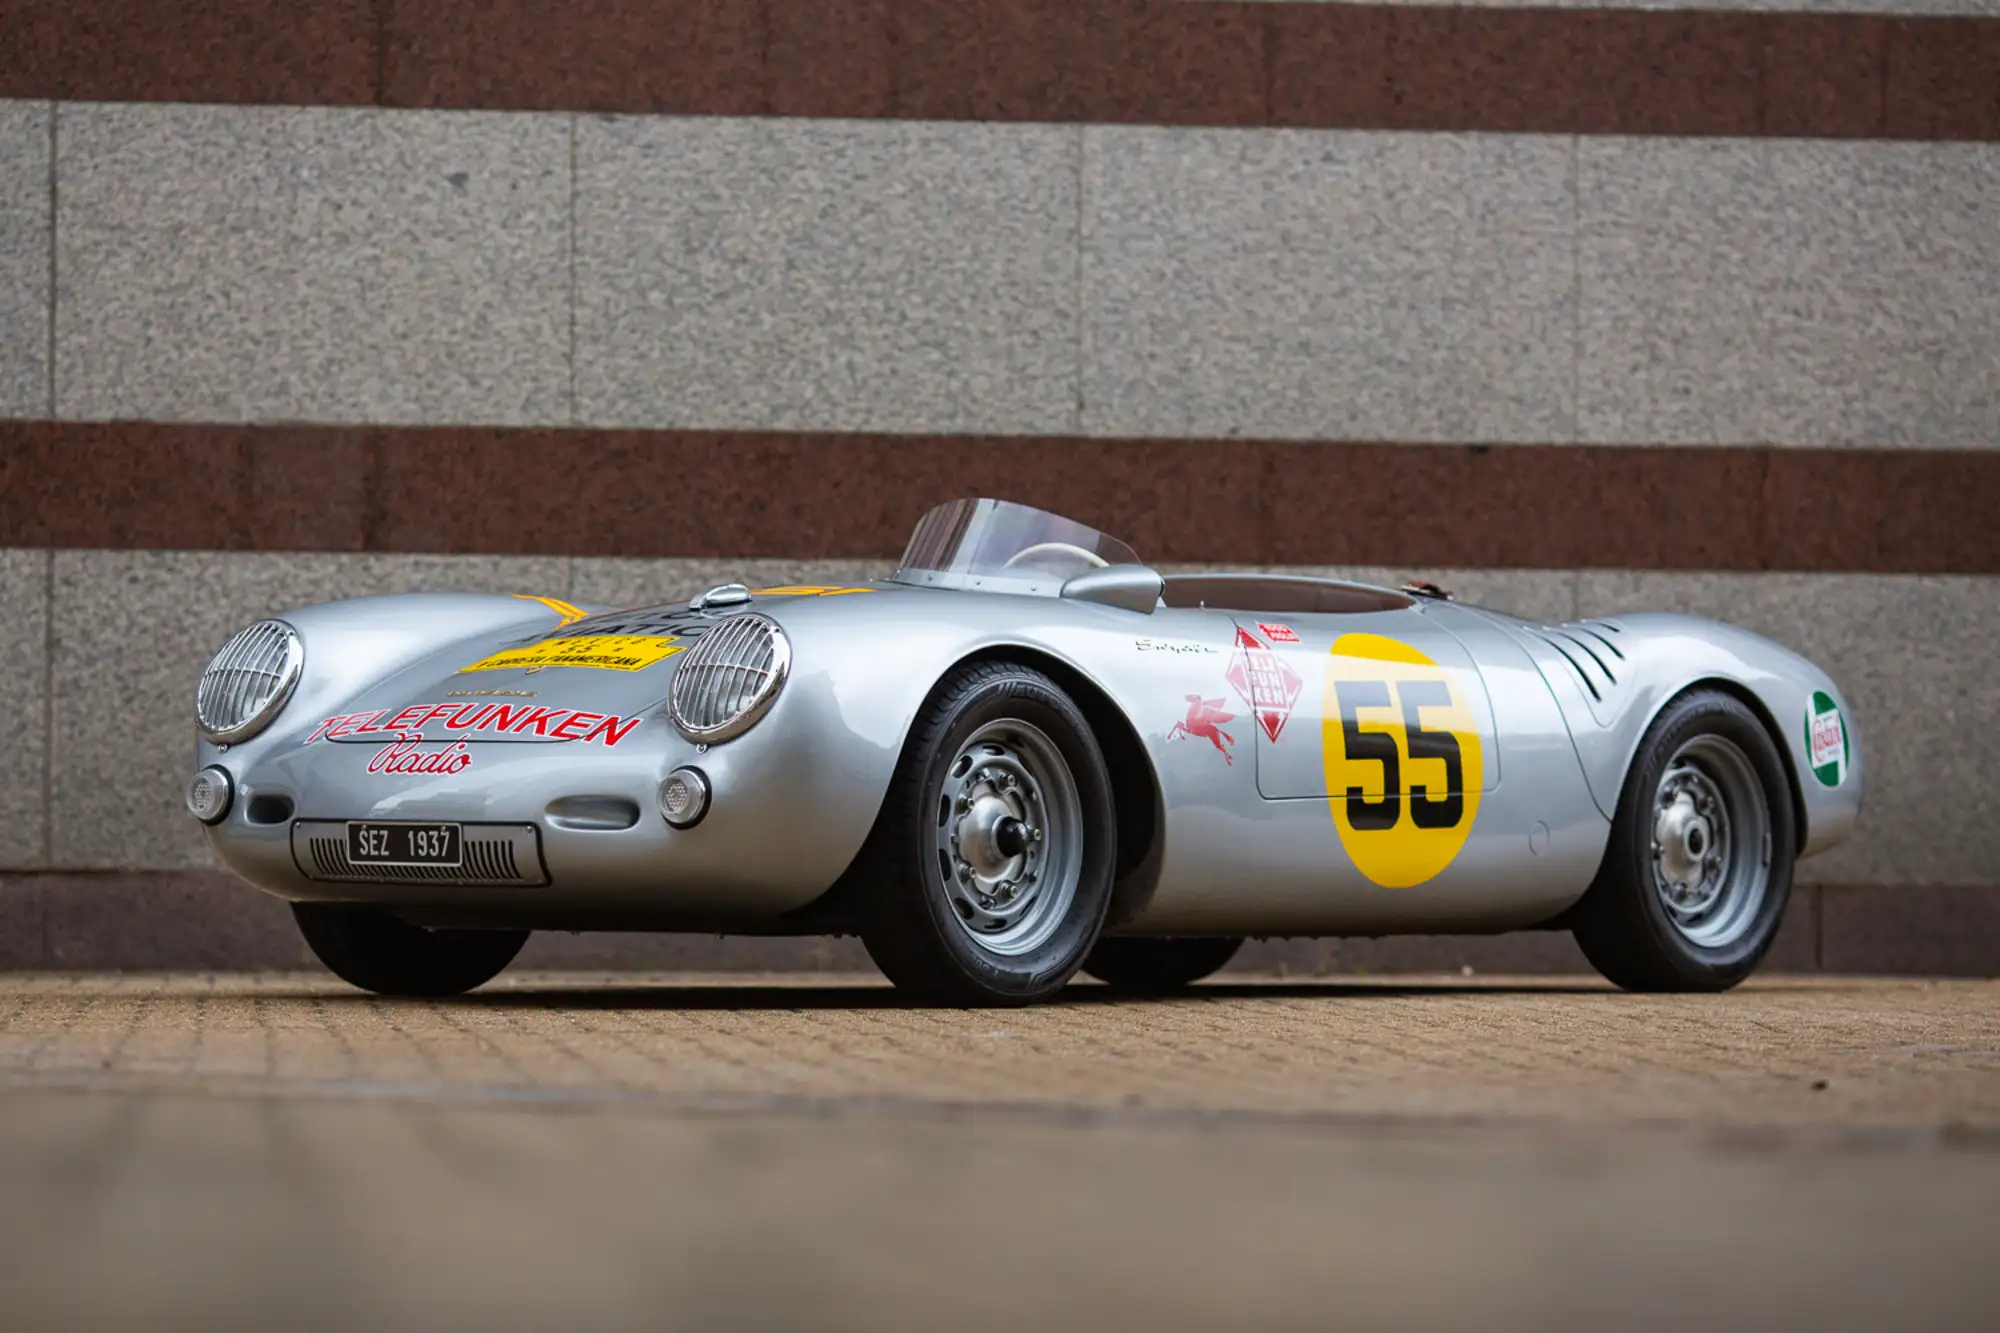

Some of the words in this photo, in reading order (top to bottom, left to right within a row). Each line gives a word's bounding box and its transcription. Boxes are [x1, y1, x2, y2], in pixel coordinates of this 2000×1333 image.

[303, 702, 643, 747] TELEFUNKEN
[366, 731, 473, 776] Radio
[1334, 680, 1464, 831] 55
[407, 830, 450, 857] 1937
